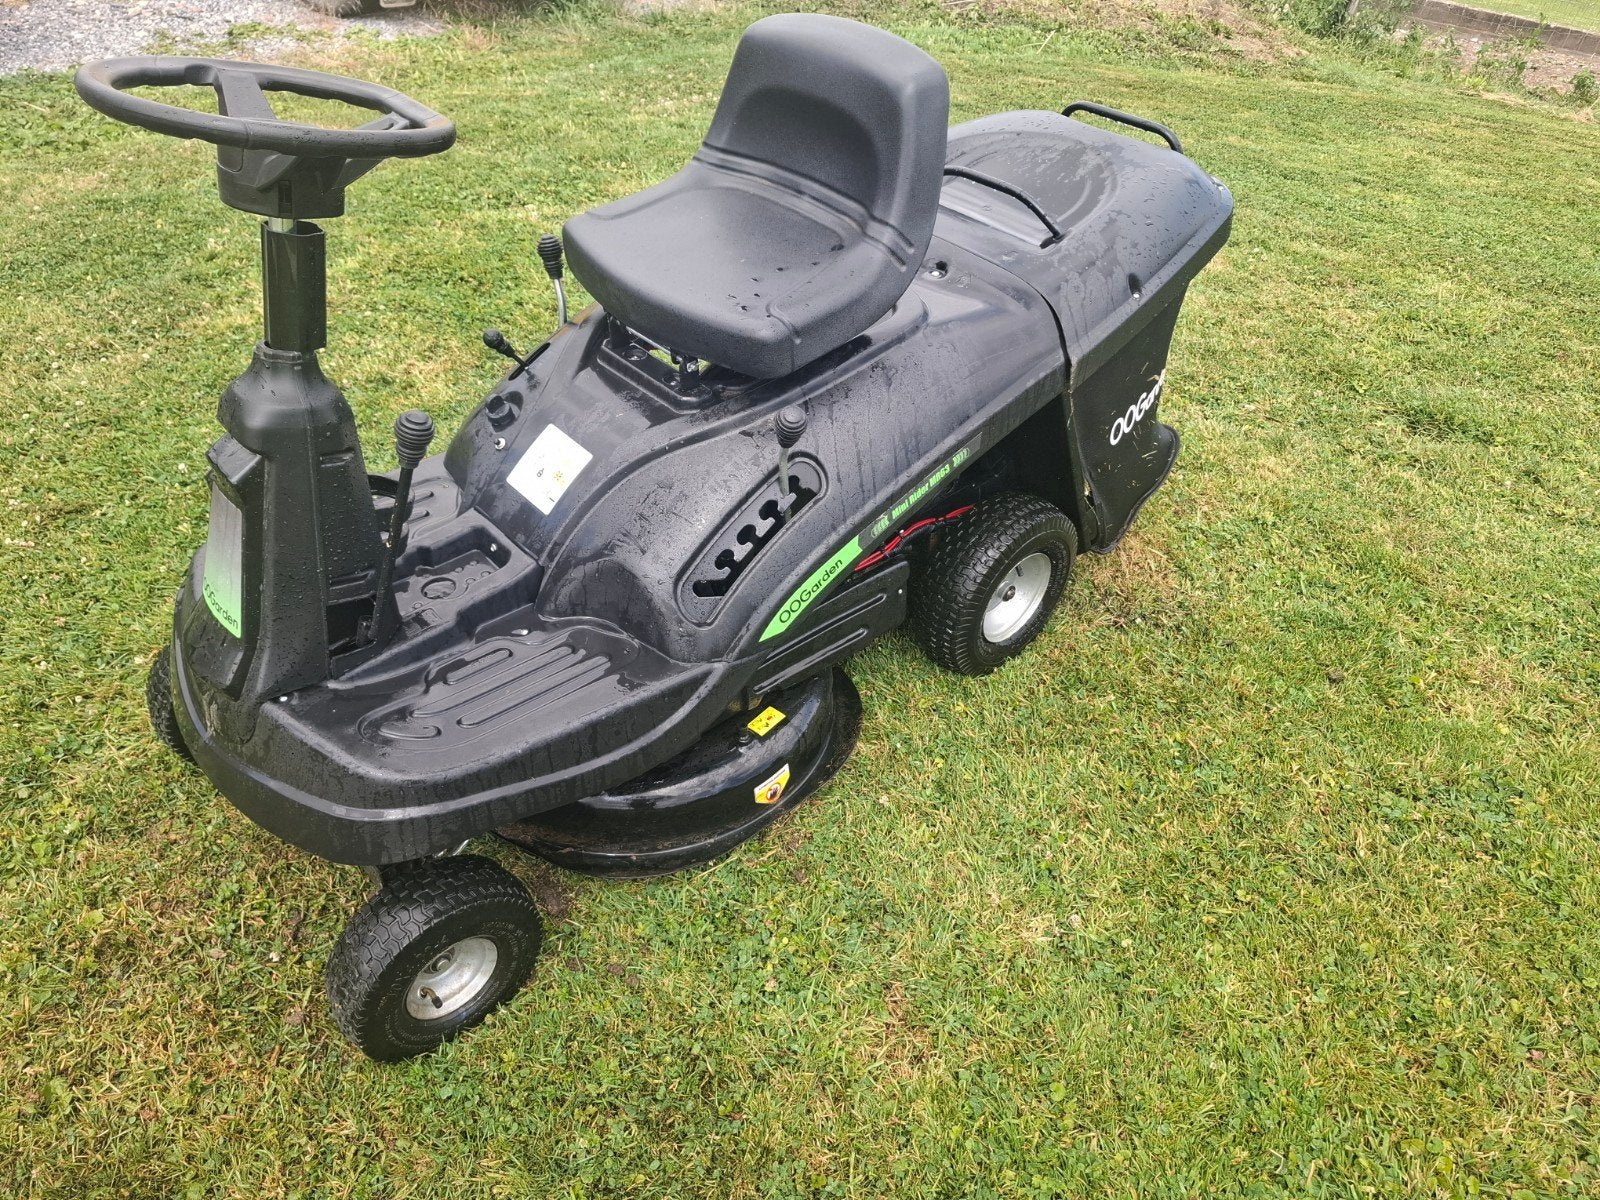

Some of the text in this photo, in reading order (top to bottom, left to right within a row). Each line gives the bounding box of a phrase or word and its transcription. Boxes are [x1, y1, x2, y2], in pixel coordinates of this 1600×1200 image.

[891, 498, 909, 519] Mini
[909, 482, 929, 505] Rider
[778, 558, 844, 624] OOGarden
